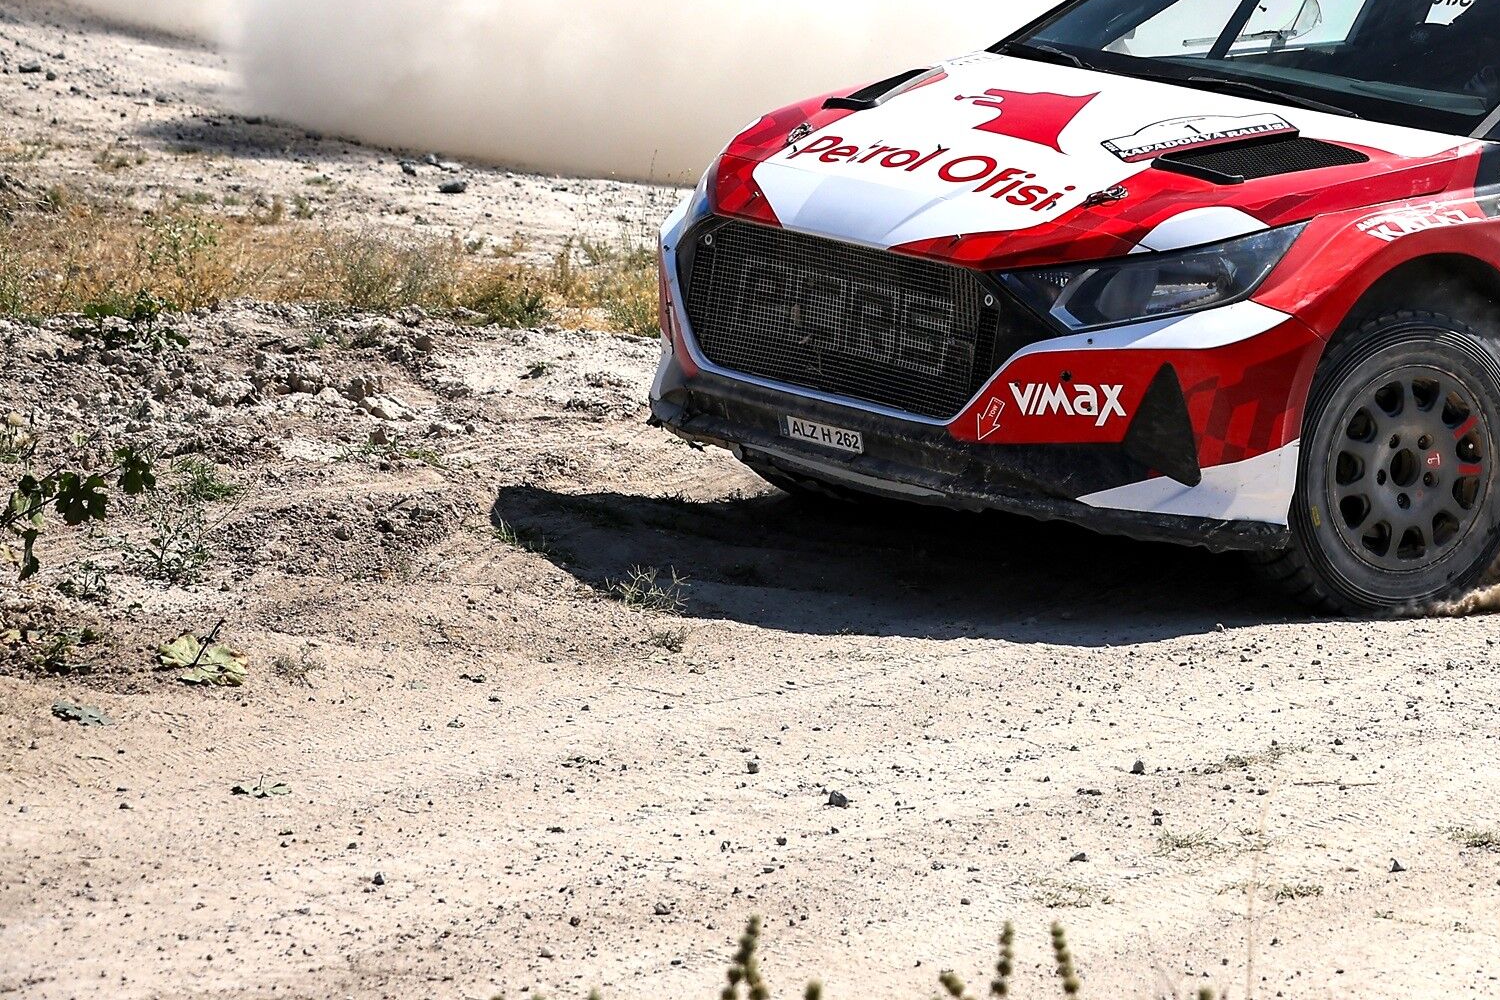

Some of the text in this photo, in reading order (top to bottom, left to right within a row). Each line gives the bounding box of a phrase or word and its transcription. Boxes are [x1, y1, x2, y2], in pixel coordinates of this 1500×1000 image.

[1120, 132, 1225, 158] KAPADOKYA
[937, 155, 1077, 212] Ofisi
[988, 404, 998, 417] TOW
[793, 421, 860, 450] ALZ H 262
